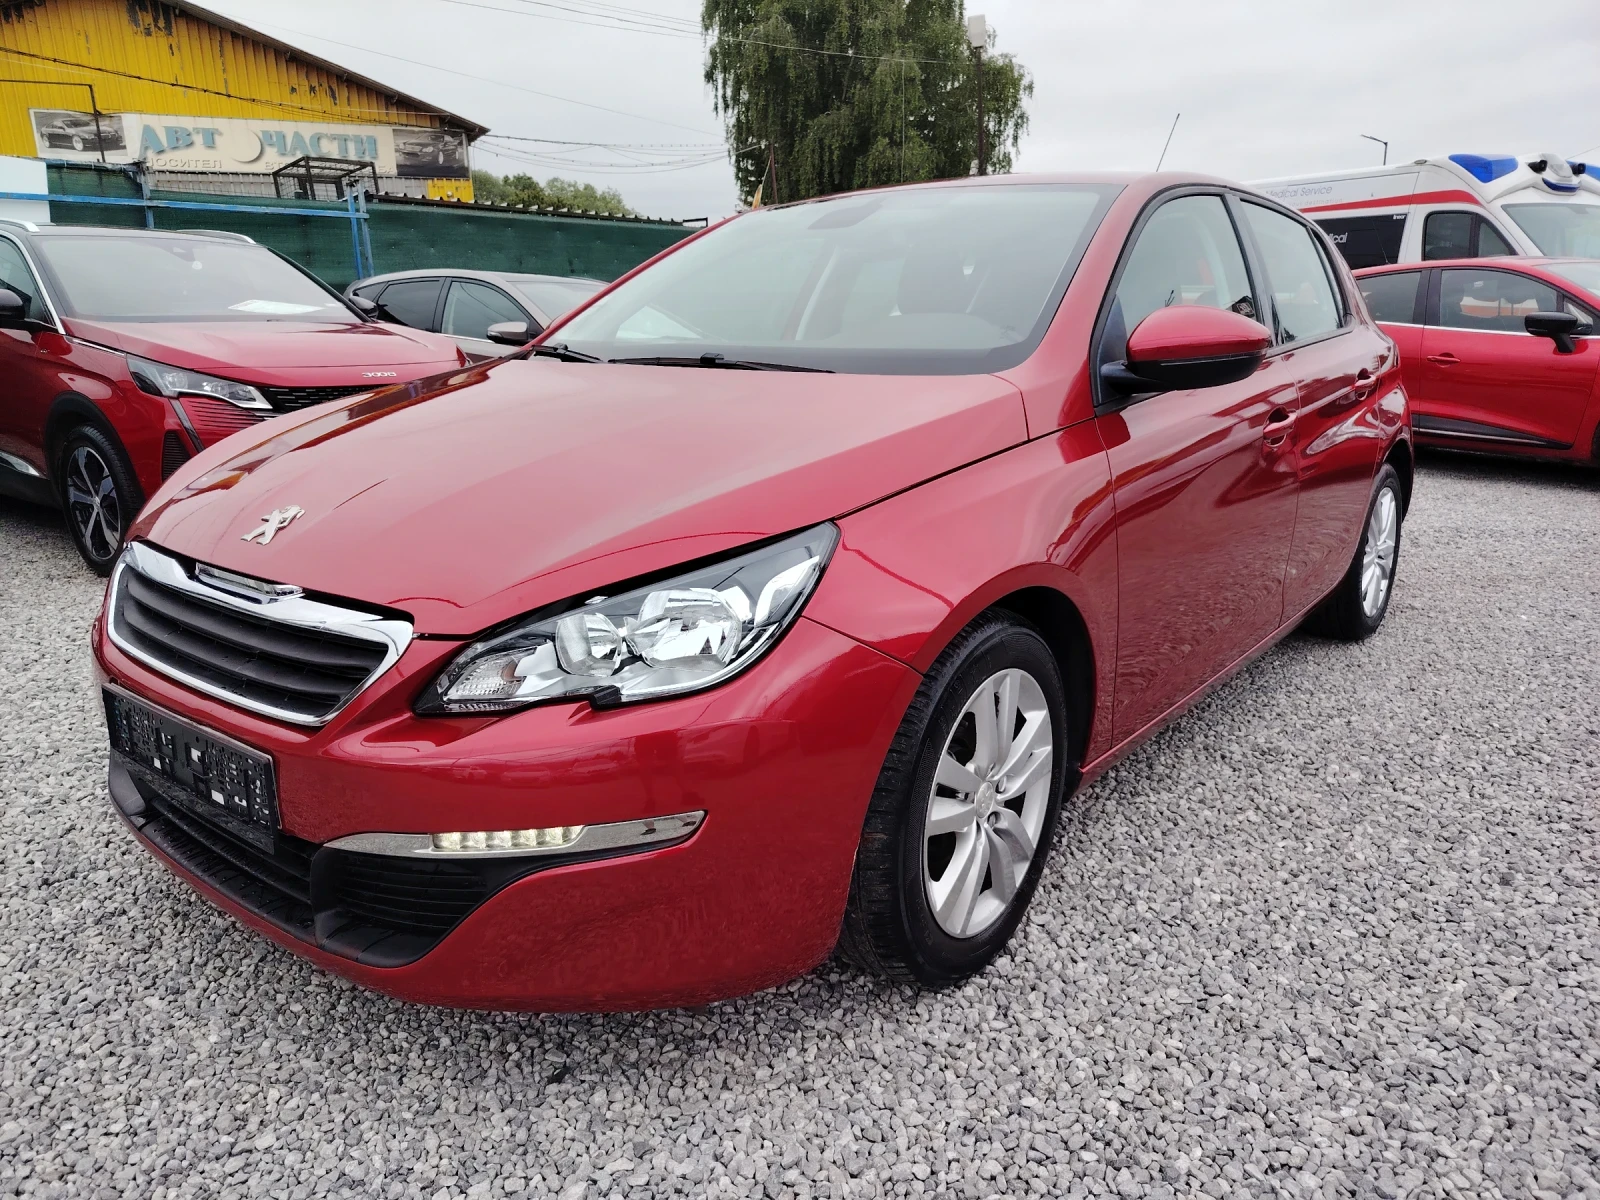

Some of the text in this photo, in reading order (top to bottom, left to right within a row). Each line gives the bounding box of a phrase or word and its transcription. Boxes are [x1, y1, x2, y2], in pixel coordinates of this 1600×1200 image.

[260, 130, 378, 159] ЧАСТИ
[1301, 186, 1332, 196] Service
[1329, 233, 1347, 243] ical
